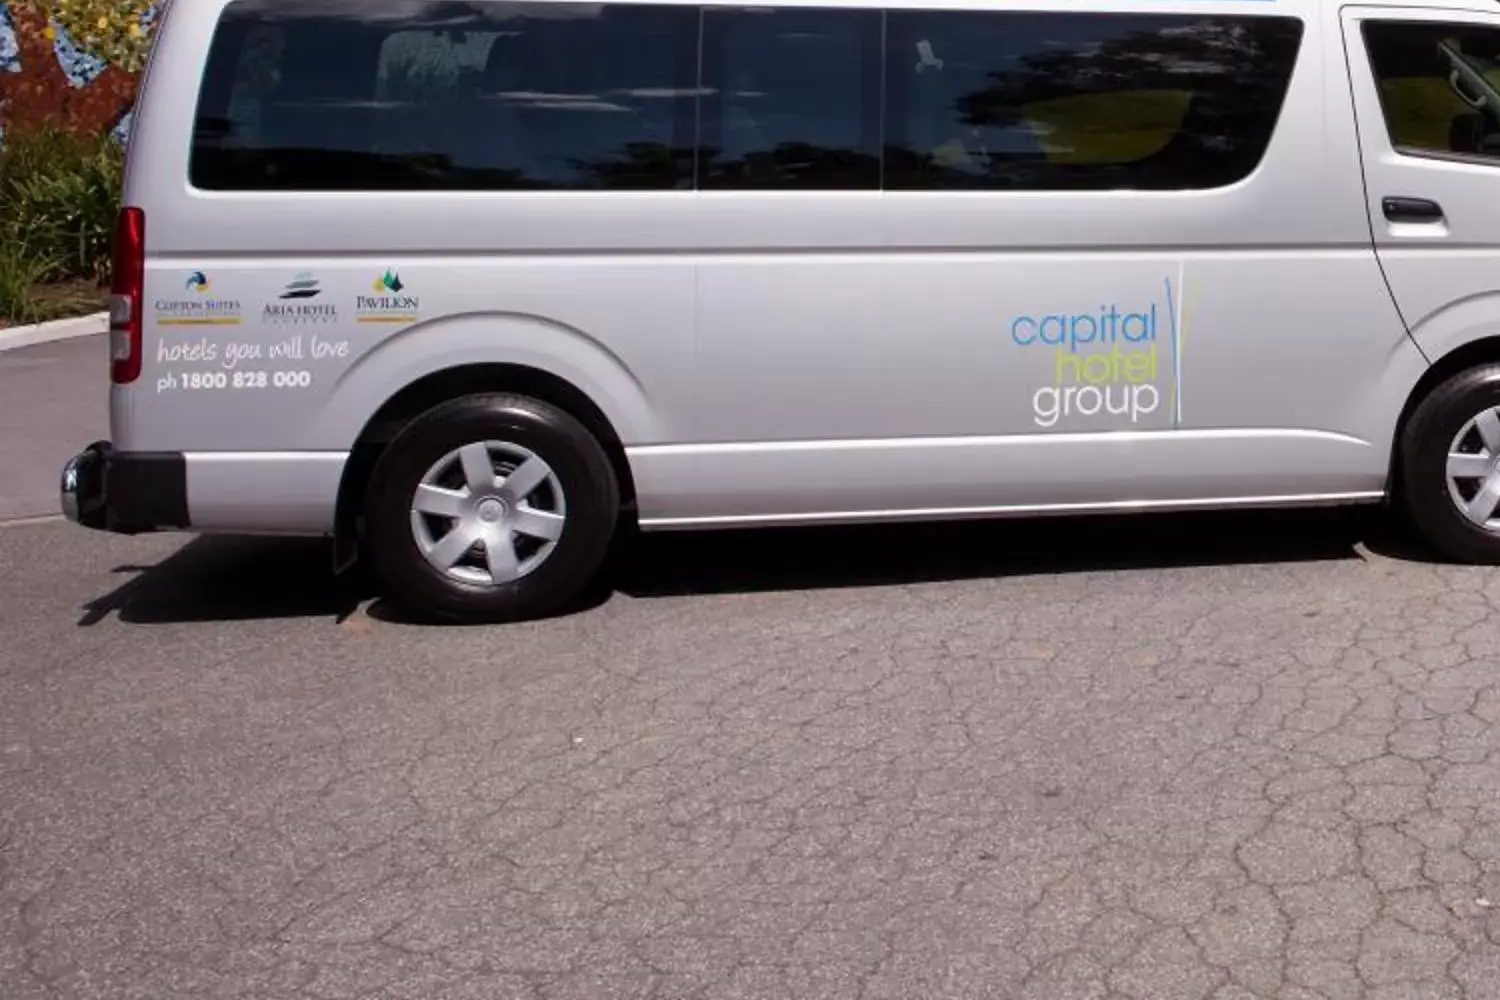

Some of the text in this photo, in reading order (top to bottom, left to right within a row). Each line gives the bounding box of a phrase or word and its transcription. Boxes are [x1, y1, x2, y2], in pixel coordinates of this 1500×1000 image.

[264, 304, 337, 315] ARIA HOTEL
[357, 296, 418, 309] PAVILION
[1011, 303, 1157, 353] capital
[157, 334, 350, 369] hotels you will love
[1055, 346, 1158, 384] hotel
[157, 370, 311, 393] ph 1800 828 000
[1032, 384, 1160, 427] group
